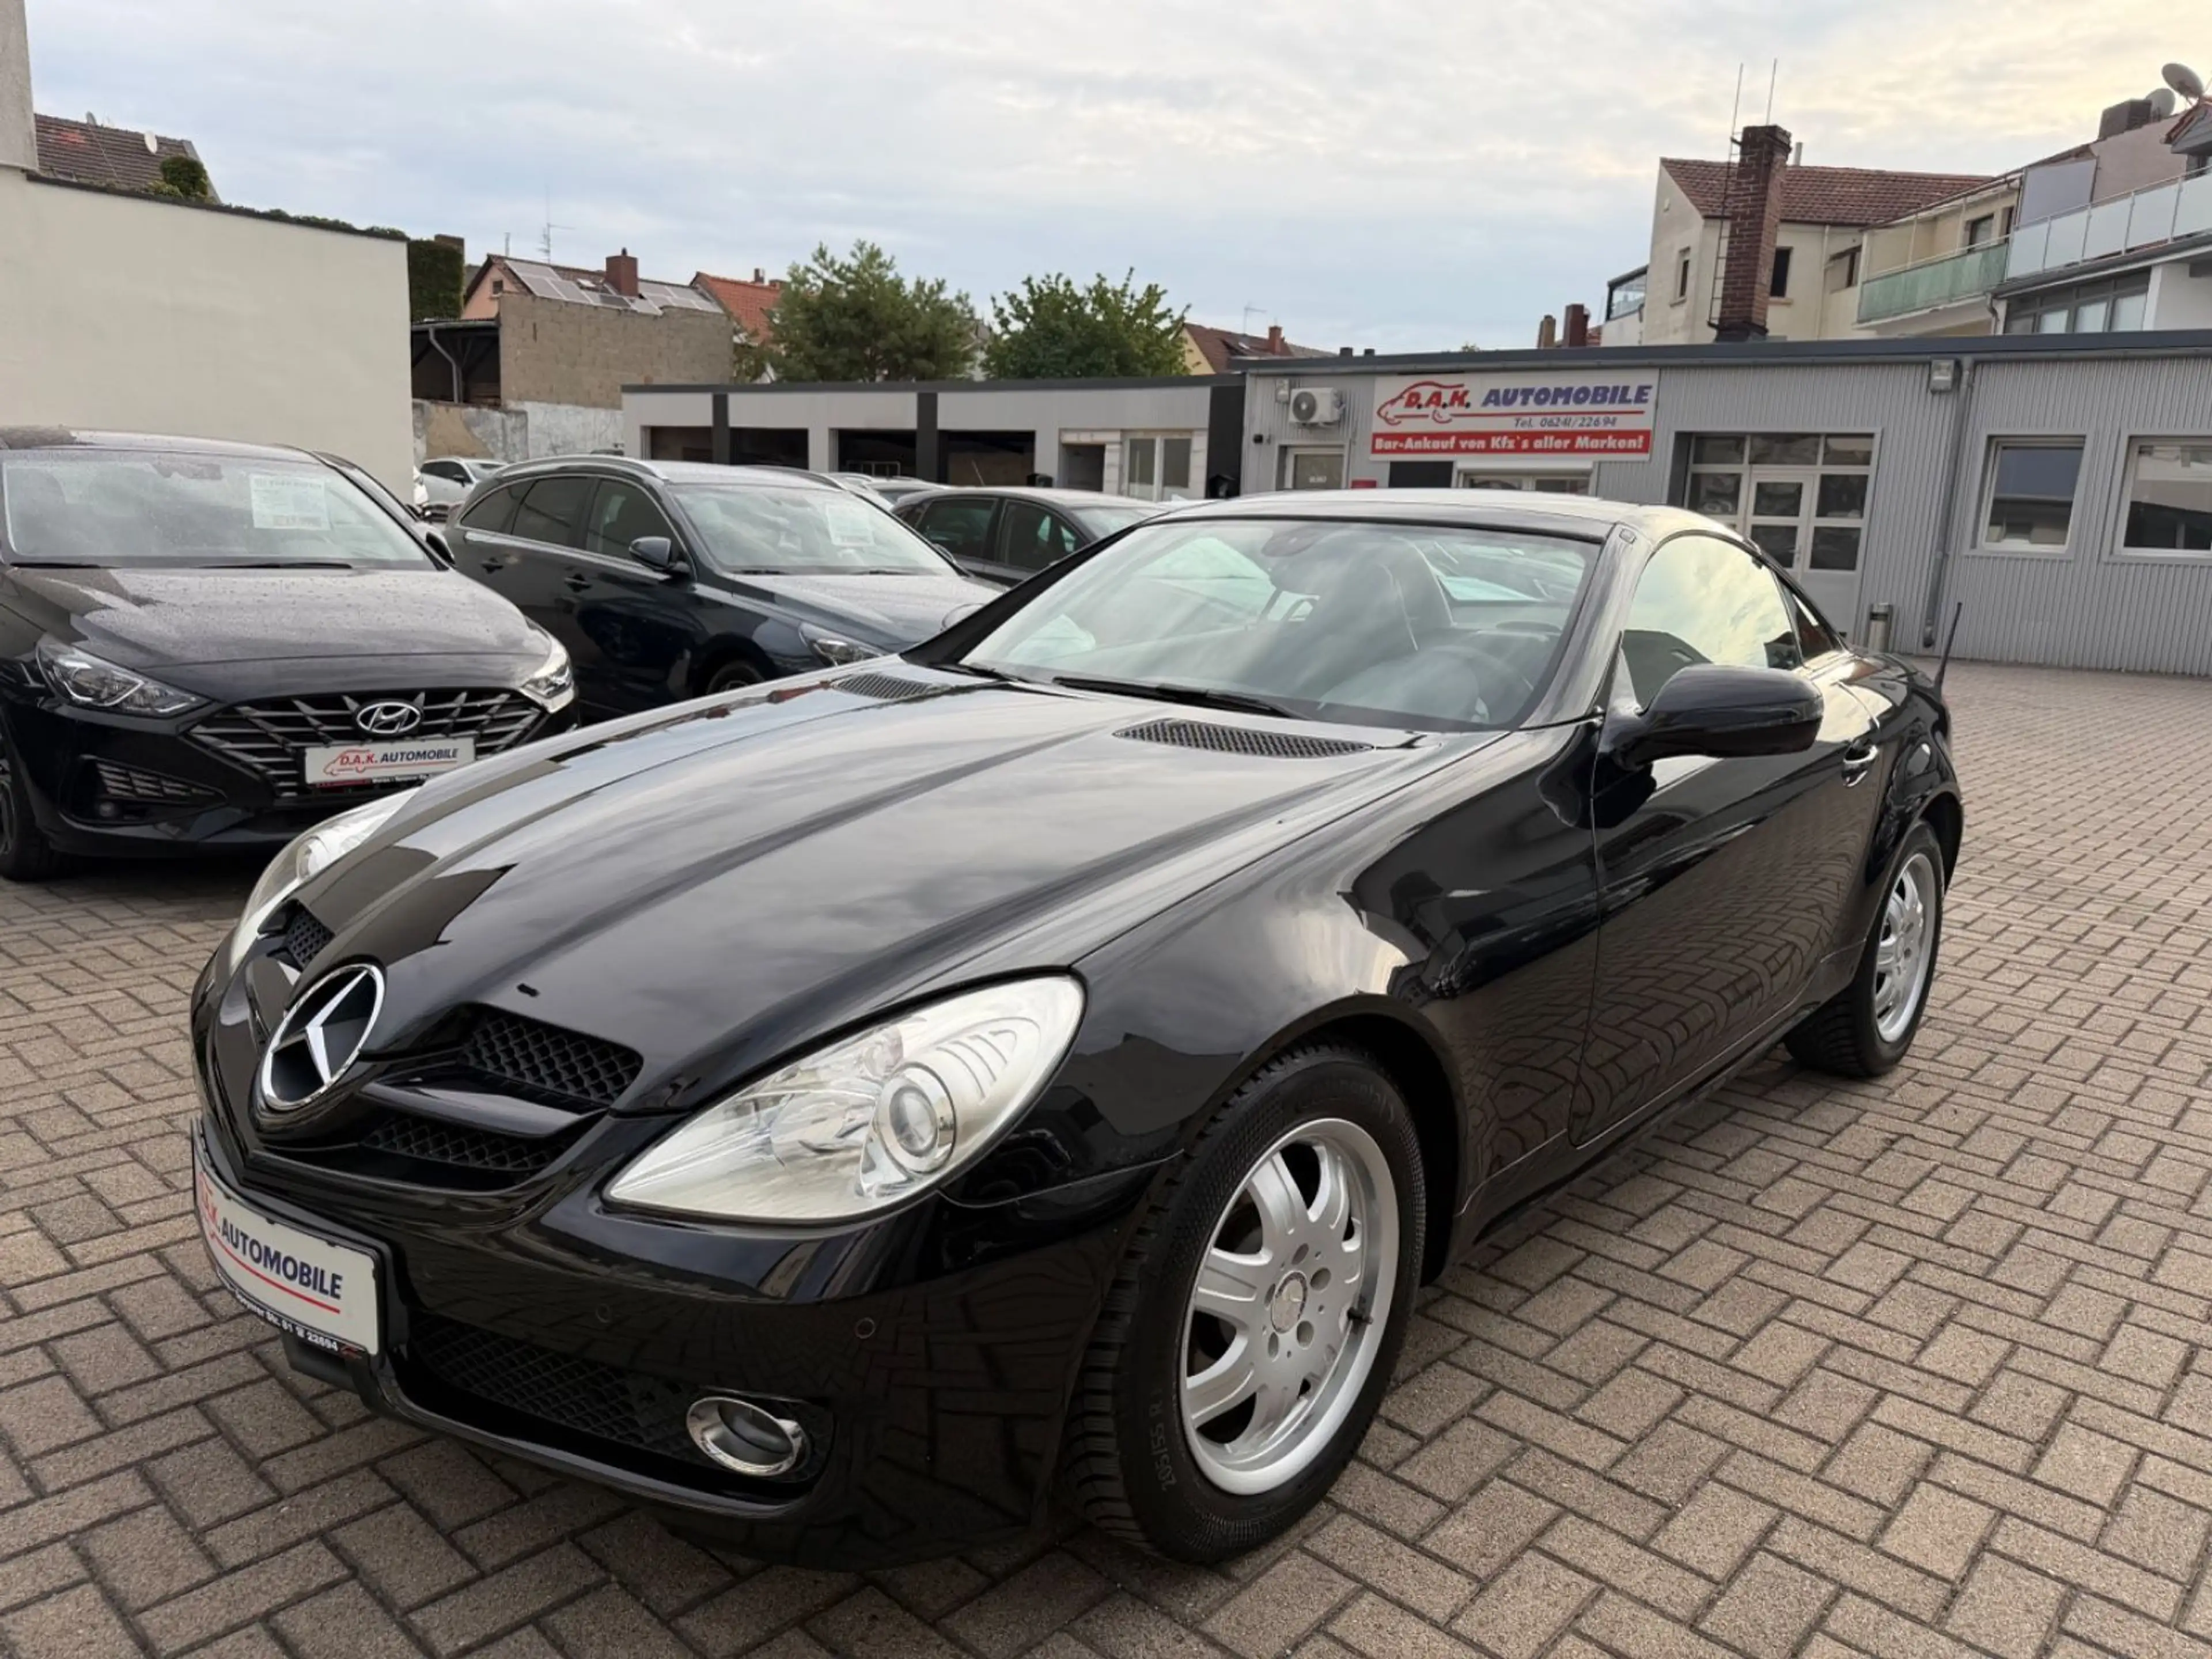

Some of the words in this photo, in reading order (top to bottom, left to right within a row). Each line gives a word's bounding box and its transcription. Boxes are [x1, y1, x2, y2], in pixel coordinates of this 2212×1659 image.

[1404, 390, 1470, 410] D.A.K.
[1482, 385, 1652, 407] AUTOMOBILE
[1514, 418, 1533, 427] Tel.
[1375, 435, 1455, 450] Bar-Ankauf
[1459, 440, 1486, 449] von
[1533, 436, 1571, 449] aller
[1574, 435, 1645, 449] Marken!
[340, 753, 377, 766] D.A.K.
[380, 749, 459, 763] AUTOMOBILE
[221, 1217, 342, 1300] AUTOMOBILE
